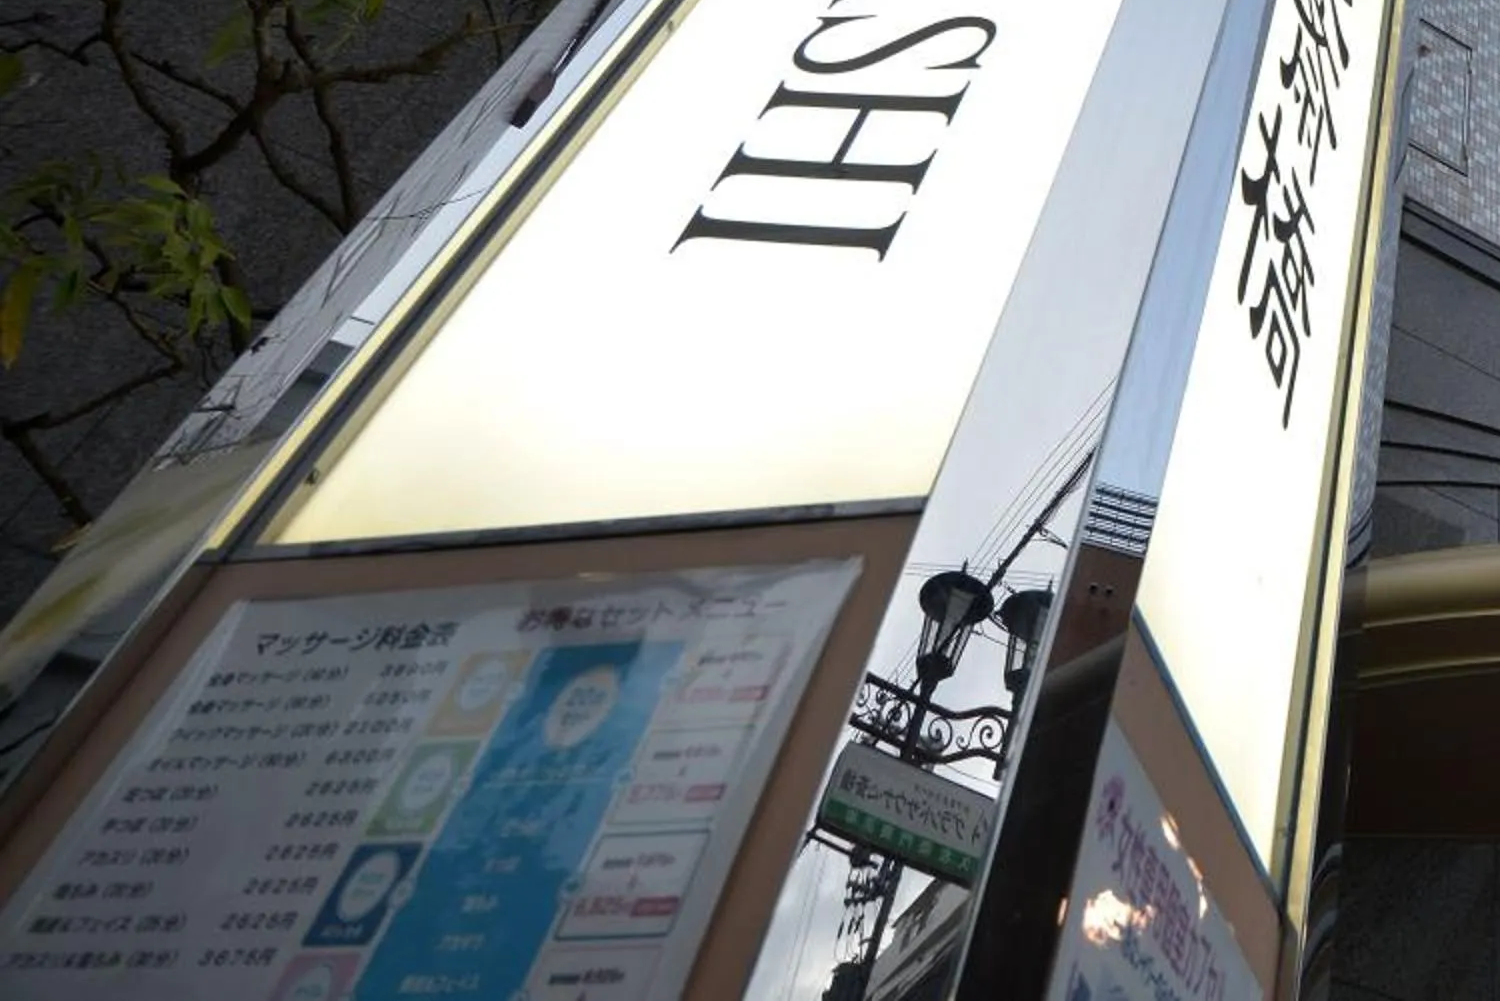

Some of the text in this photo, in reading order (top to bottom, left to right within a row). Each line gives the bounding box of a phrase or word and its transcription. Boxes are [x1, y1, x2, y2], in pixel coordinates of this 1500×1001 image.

[253, 620, 459, 656] マッサージ料金表
